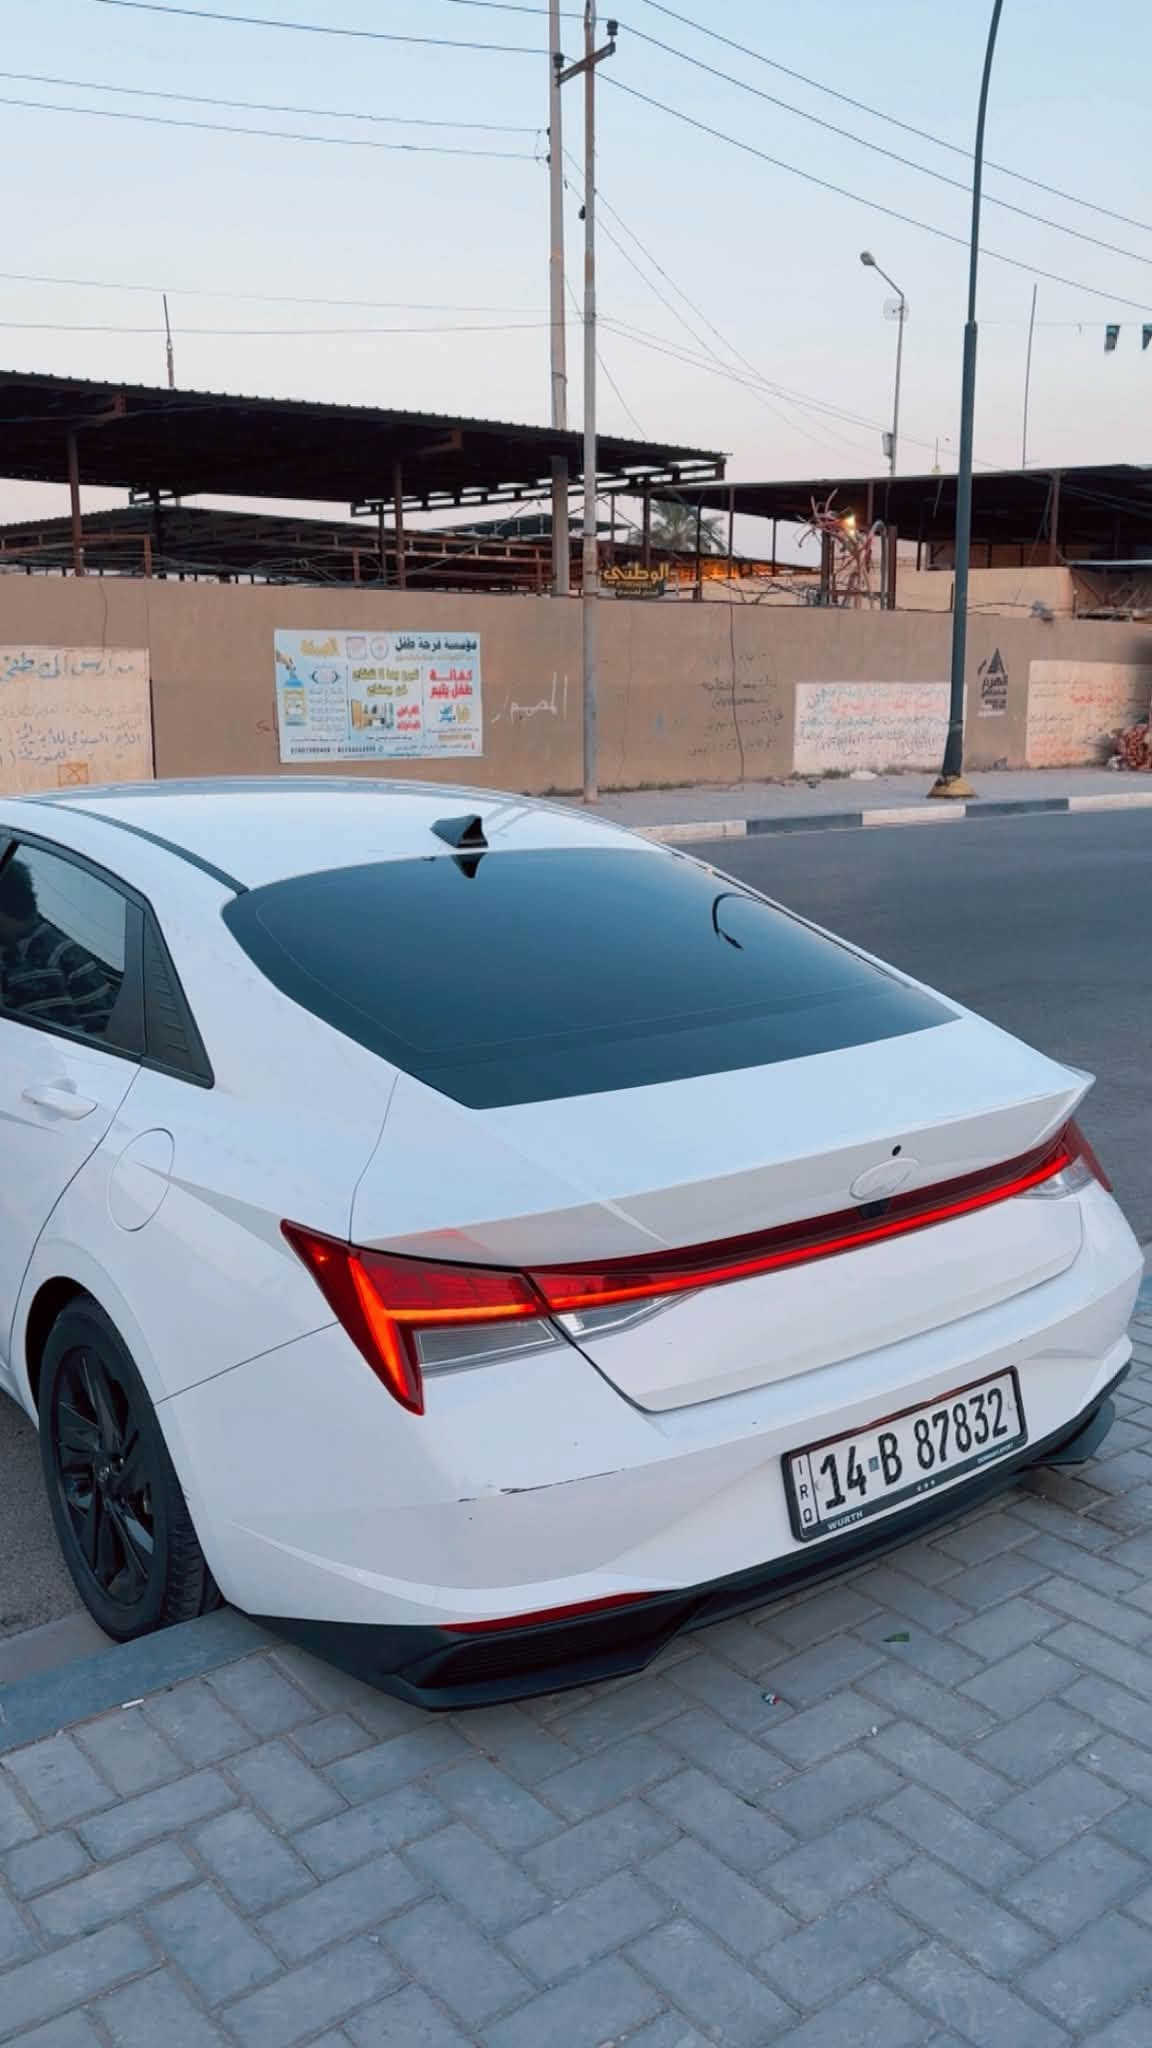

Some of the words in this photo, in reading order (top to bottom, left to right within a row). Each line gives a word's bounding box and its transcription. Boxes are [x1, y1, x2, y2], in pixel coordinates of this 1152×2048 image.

[820, 1445, 867, 1510] 14
[877, 1432, 902, 1486] B
[913, 1387, 1008, 1471] 87832
